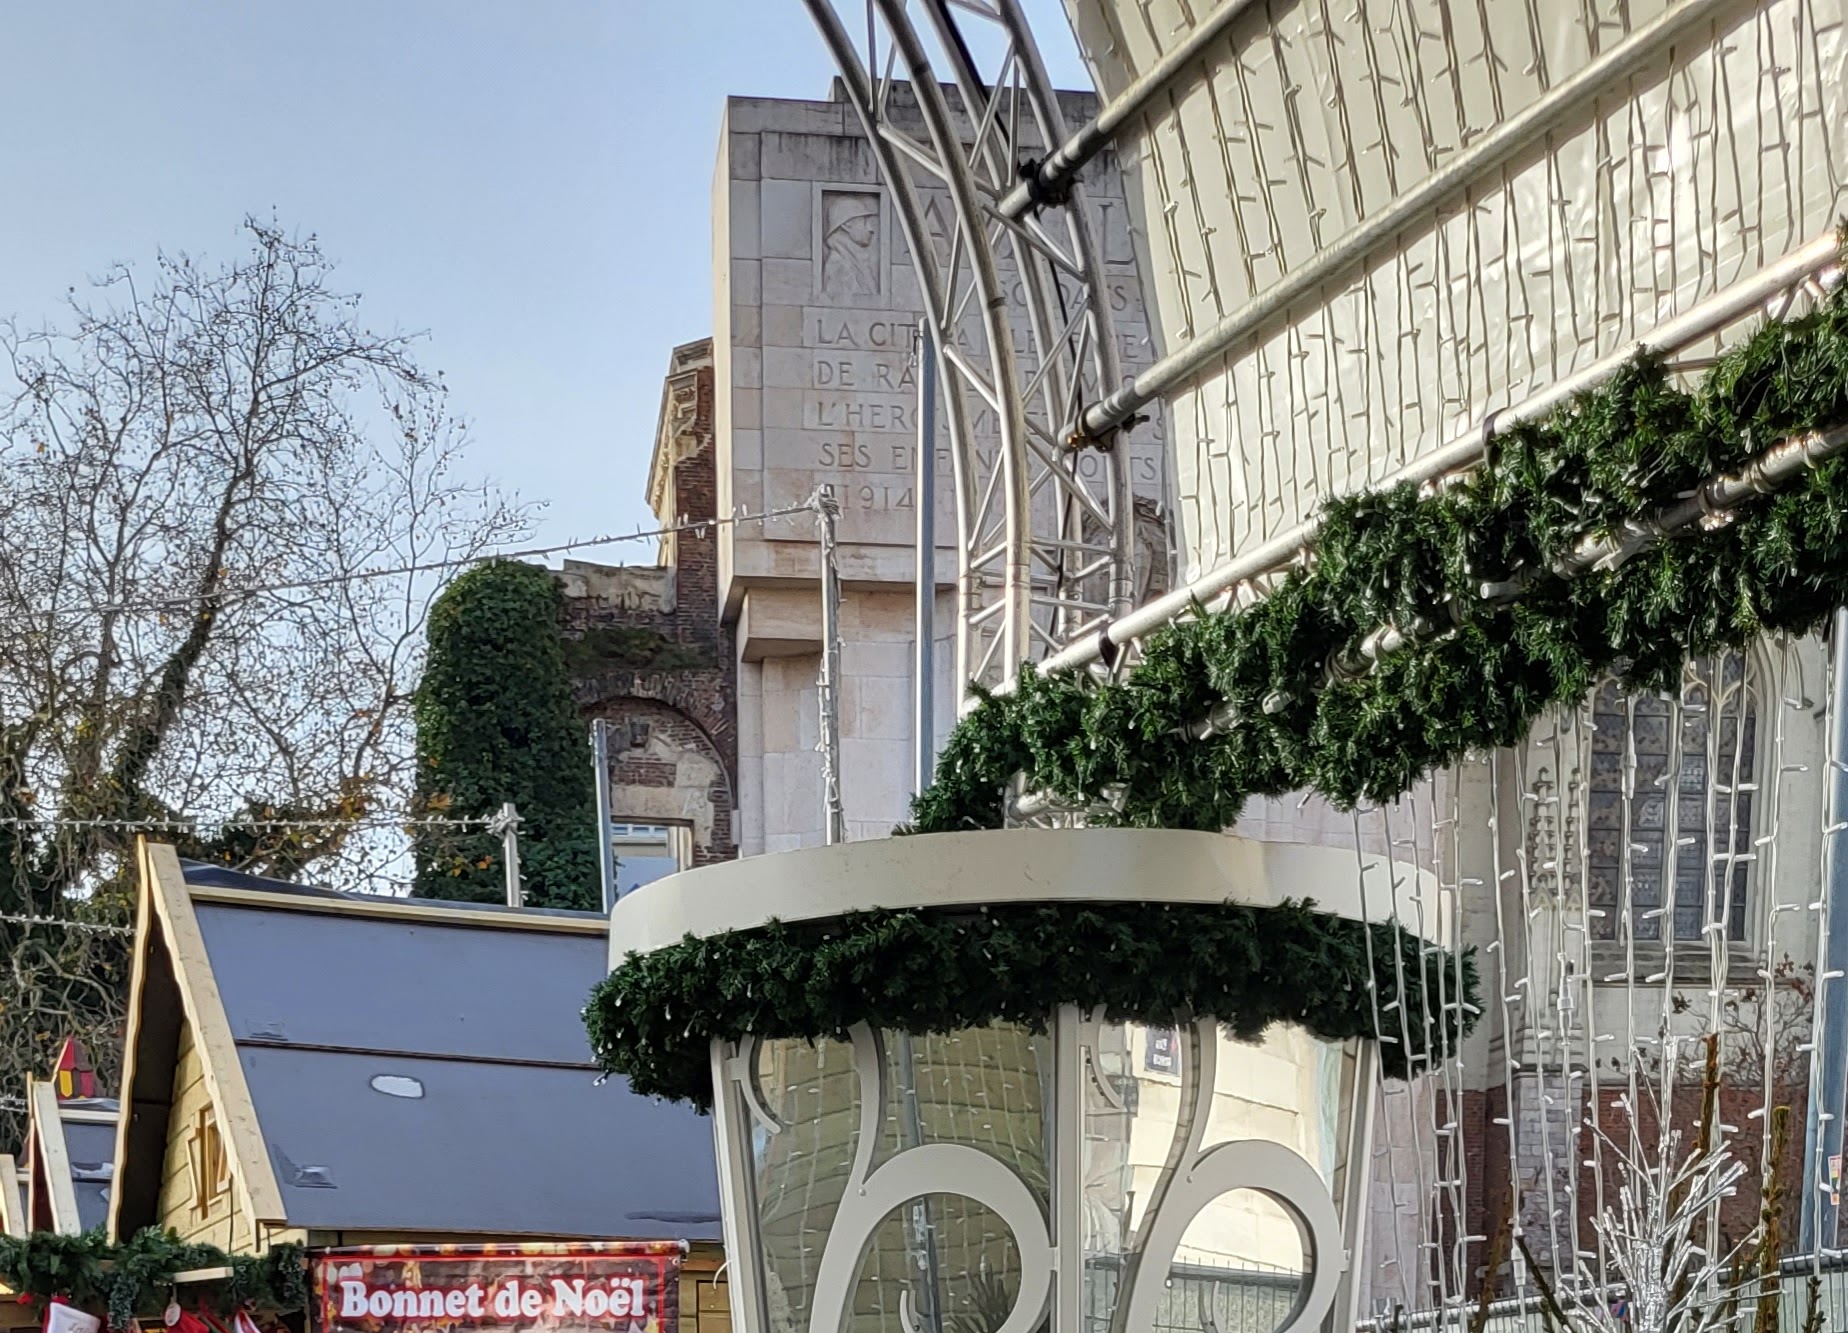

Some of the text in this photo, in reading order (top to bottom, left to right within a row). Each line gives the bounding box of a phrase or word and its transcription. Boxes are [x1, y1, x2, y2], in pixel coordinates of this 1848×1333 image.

[817, 319, 859, 348] LA
[817, 361, 855, 387] DE
[818, 442, 872, 469] SES
[340, 1277, 645, 1318] Bonnet de Noël
